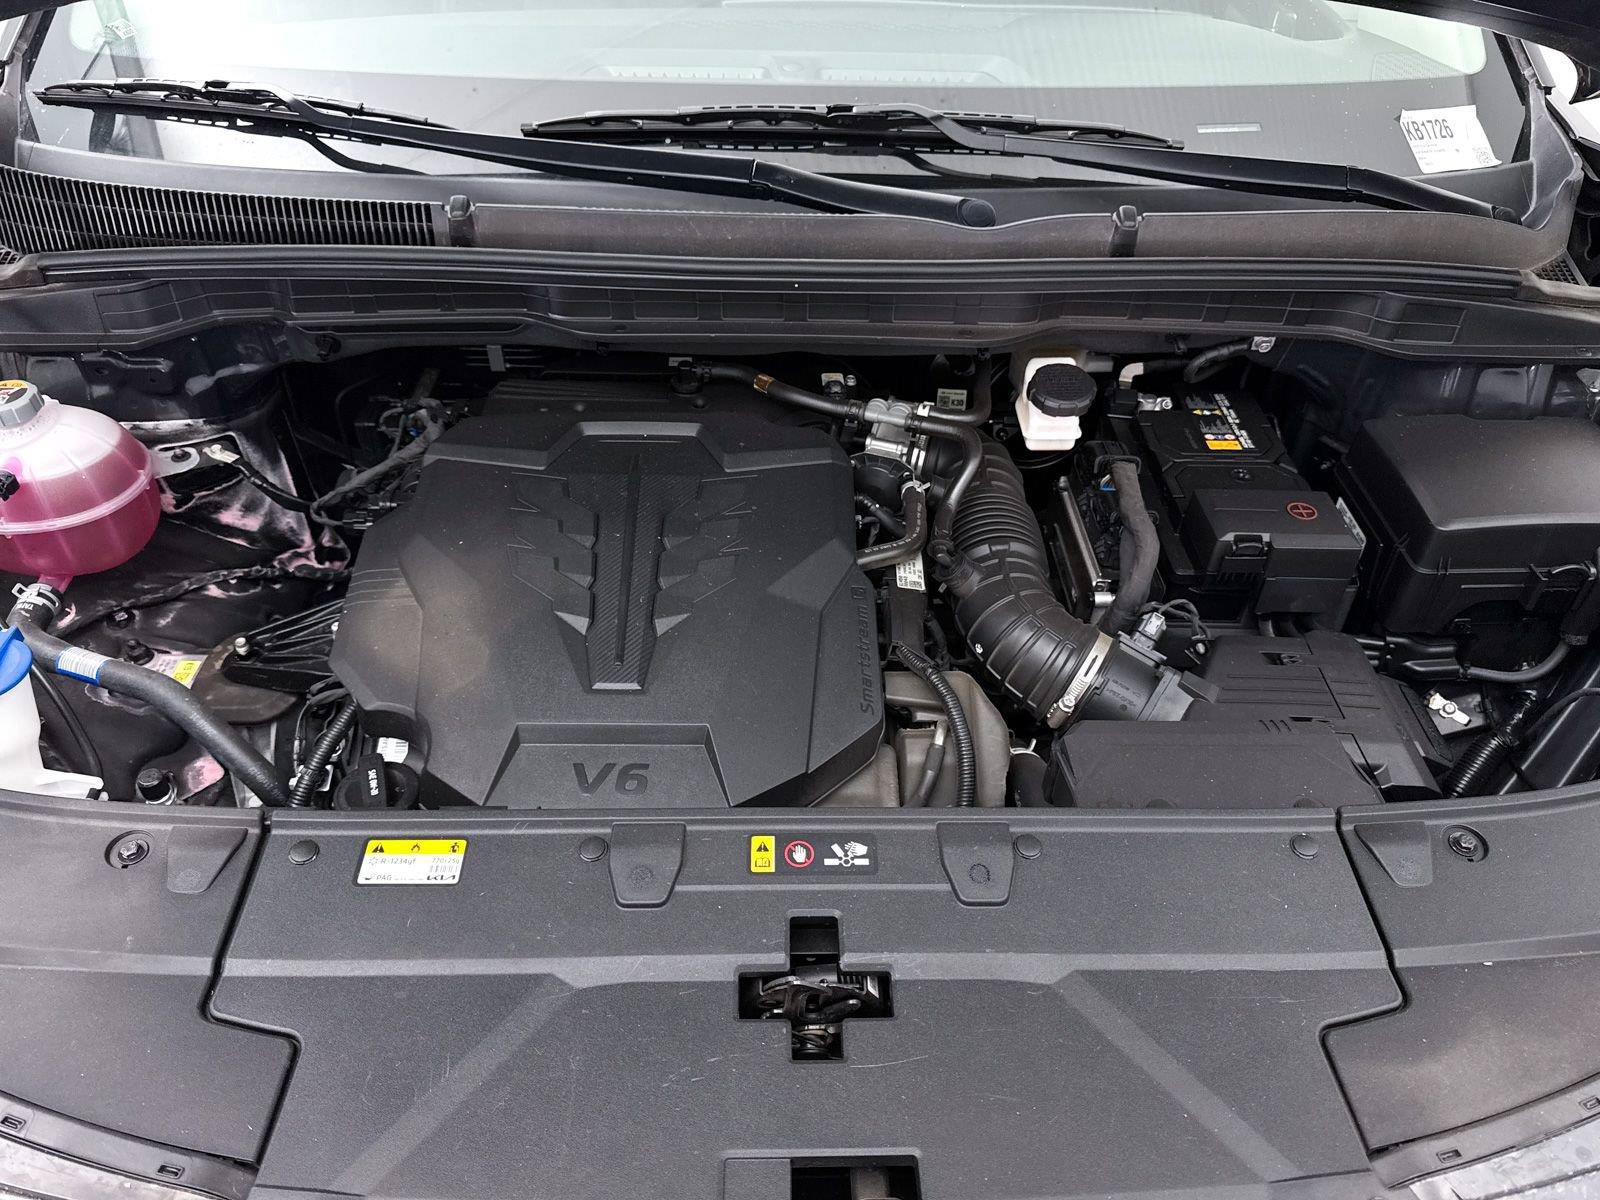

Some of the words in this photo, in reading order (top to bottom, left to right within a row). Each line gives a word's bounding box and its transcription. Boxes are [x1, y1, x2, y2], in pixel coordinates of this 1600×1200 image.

[1402, 118, 1454, 141] KB1726
[857, 604, 875, 716] Smartstream
[572, 763, 650, 796] V6
